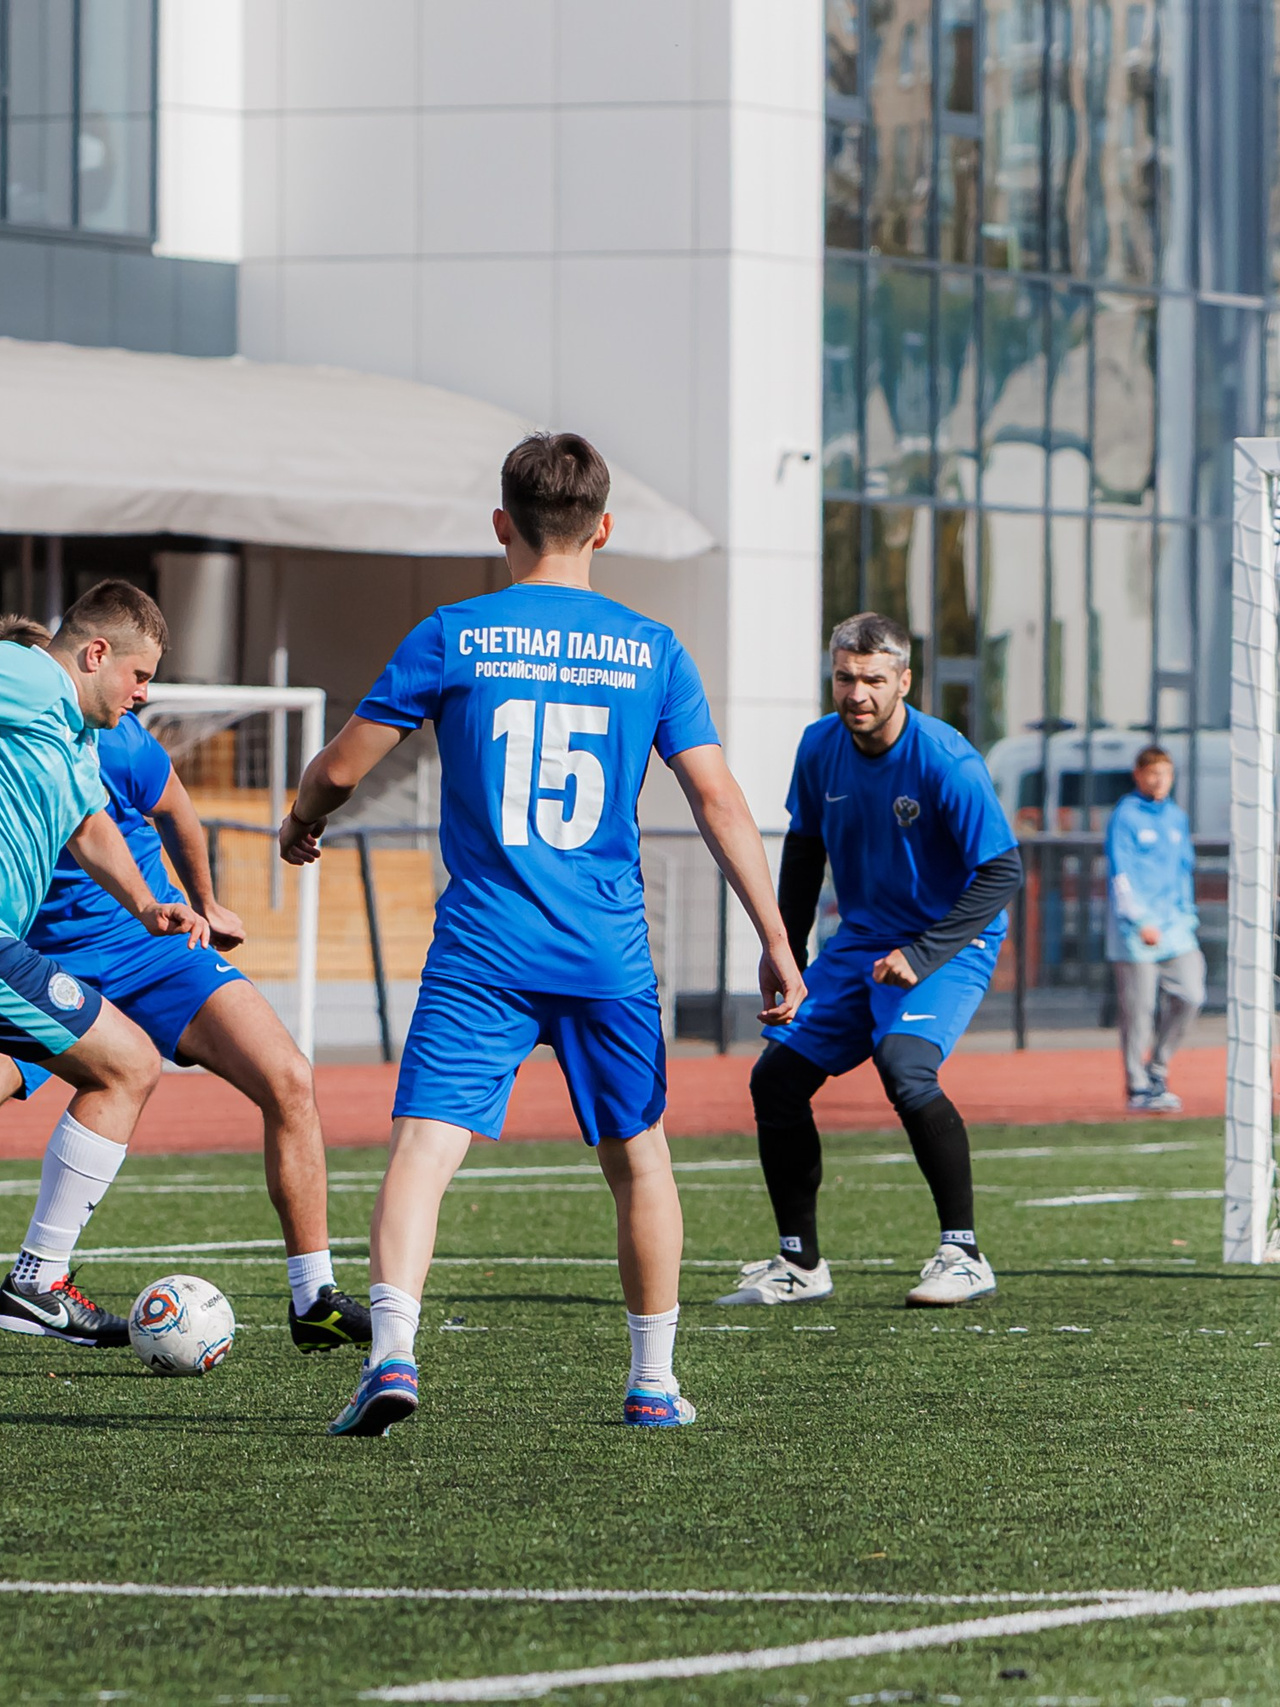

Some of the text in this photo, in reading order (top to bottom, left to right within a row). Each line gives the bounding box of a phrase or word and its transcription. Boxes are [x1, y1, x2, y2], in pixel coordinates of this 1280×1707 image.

[459, 626, 653, 669] СЧЕТНАЯ ПАЛАТА
[475, 660, 636, 689] РОССИЙСКОЙ ФЕДЕРАЦИИ
[492, 699, 610, 850] 15
